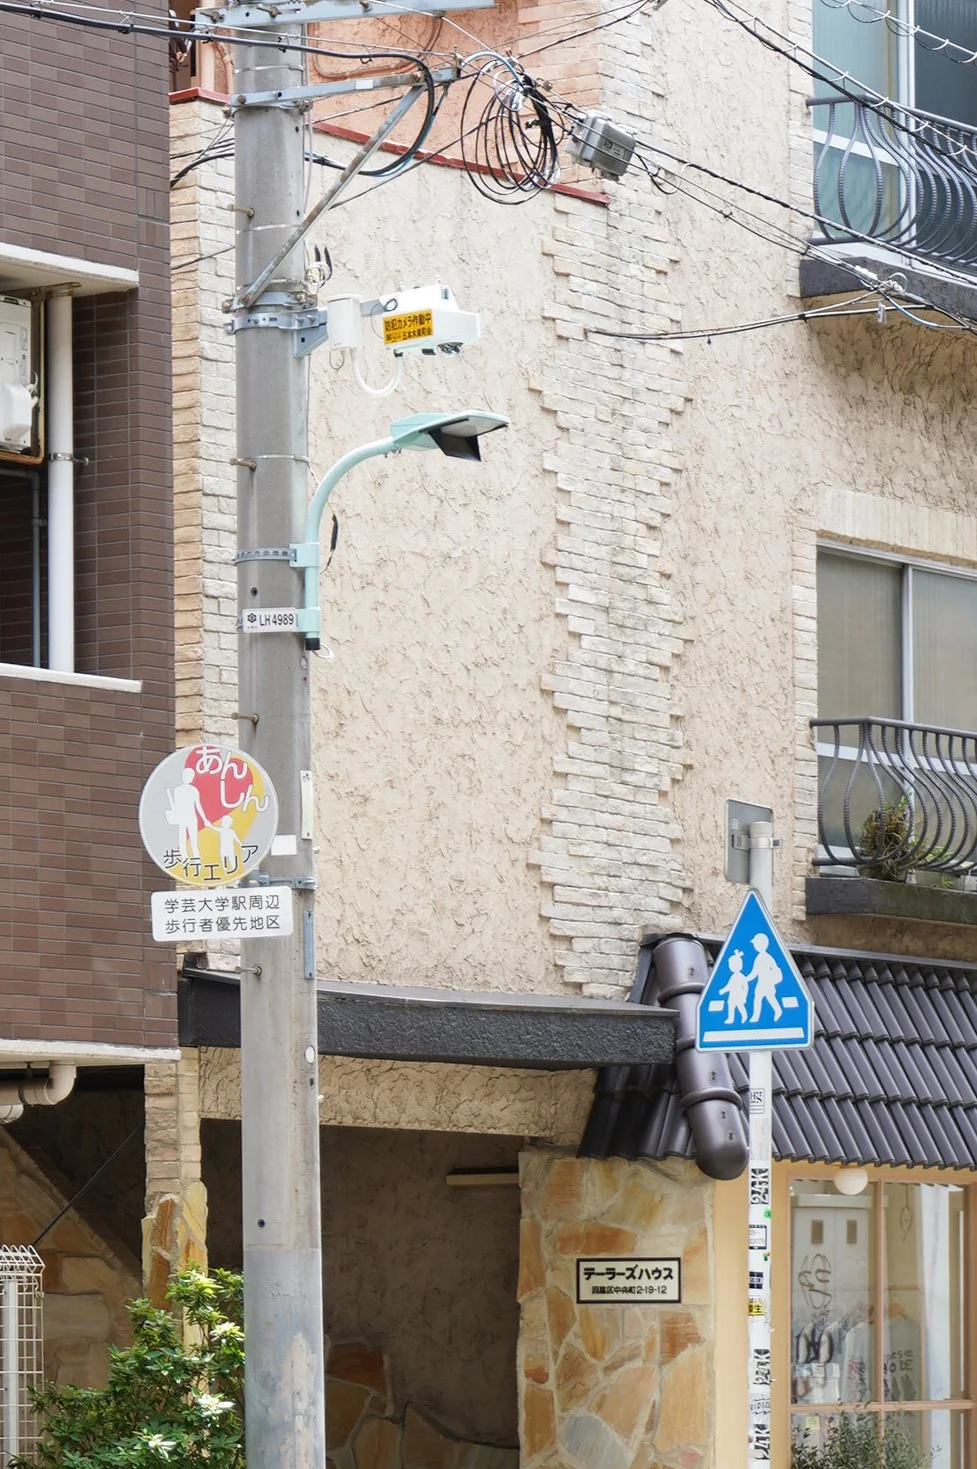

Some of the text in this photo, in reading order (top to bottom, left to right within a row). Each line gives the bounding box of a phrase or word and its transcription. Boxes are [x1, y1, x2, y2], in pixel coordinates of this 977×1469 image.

[384, 313, 432, 331] 防犯カメラ作動中
[195, 746, 248, 780] あん
[220, 778, 269, 813] しん
[163, 844, 259, 881] 歩行エリア
[164, 894, 280, 914] 学芸大学駅周辺
[165, 914, 280, 935] 歩行者優先地区
[583, 1264, 674, 1281] テーラーズハウス
